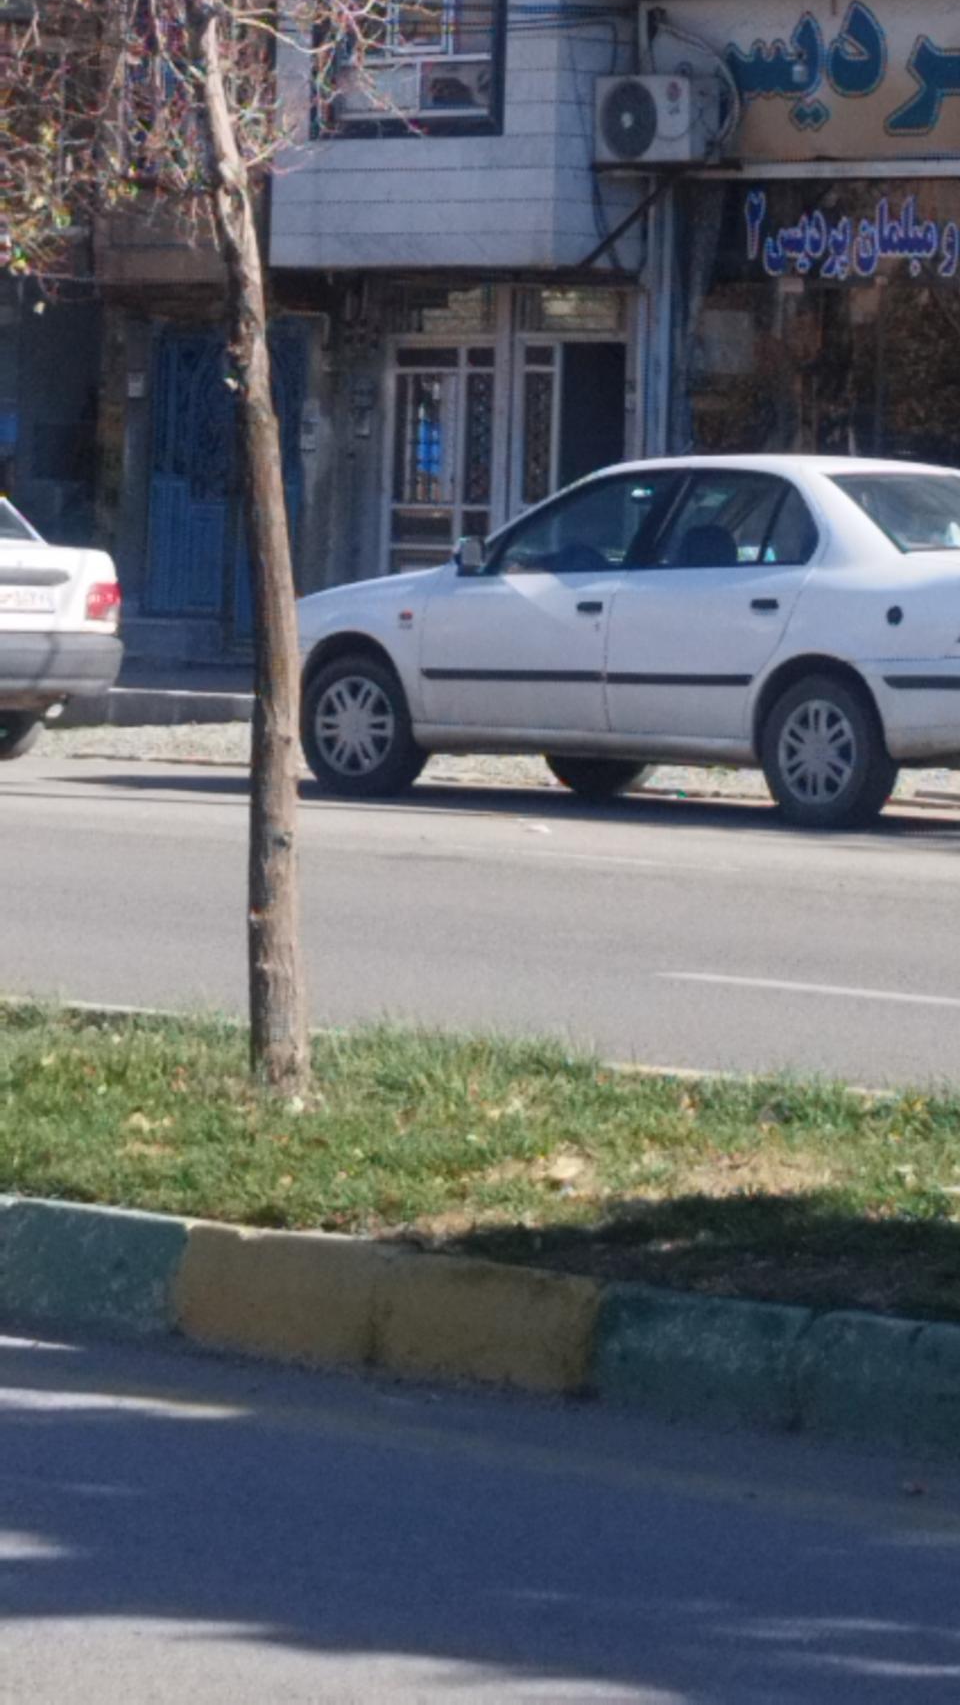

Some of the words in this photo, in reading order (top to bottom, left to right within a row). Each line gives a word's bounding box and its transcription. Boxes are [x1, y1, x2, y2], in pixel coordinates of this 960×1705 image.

[763, 209, 851, 281] پردیس
[853, 196, 938, 277] مبلمان
[938, 221, 960, 277] و
